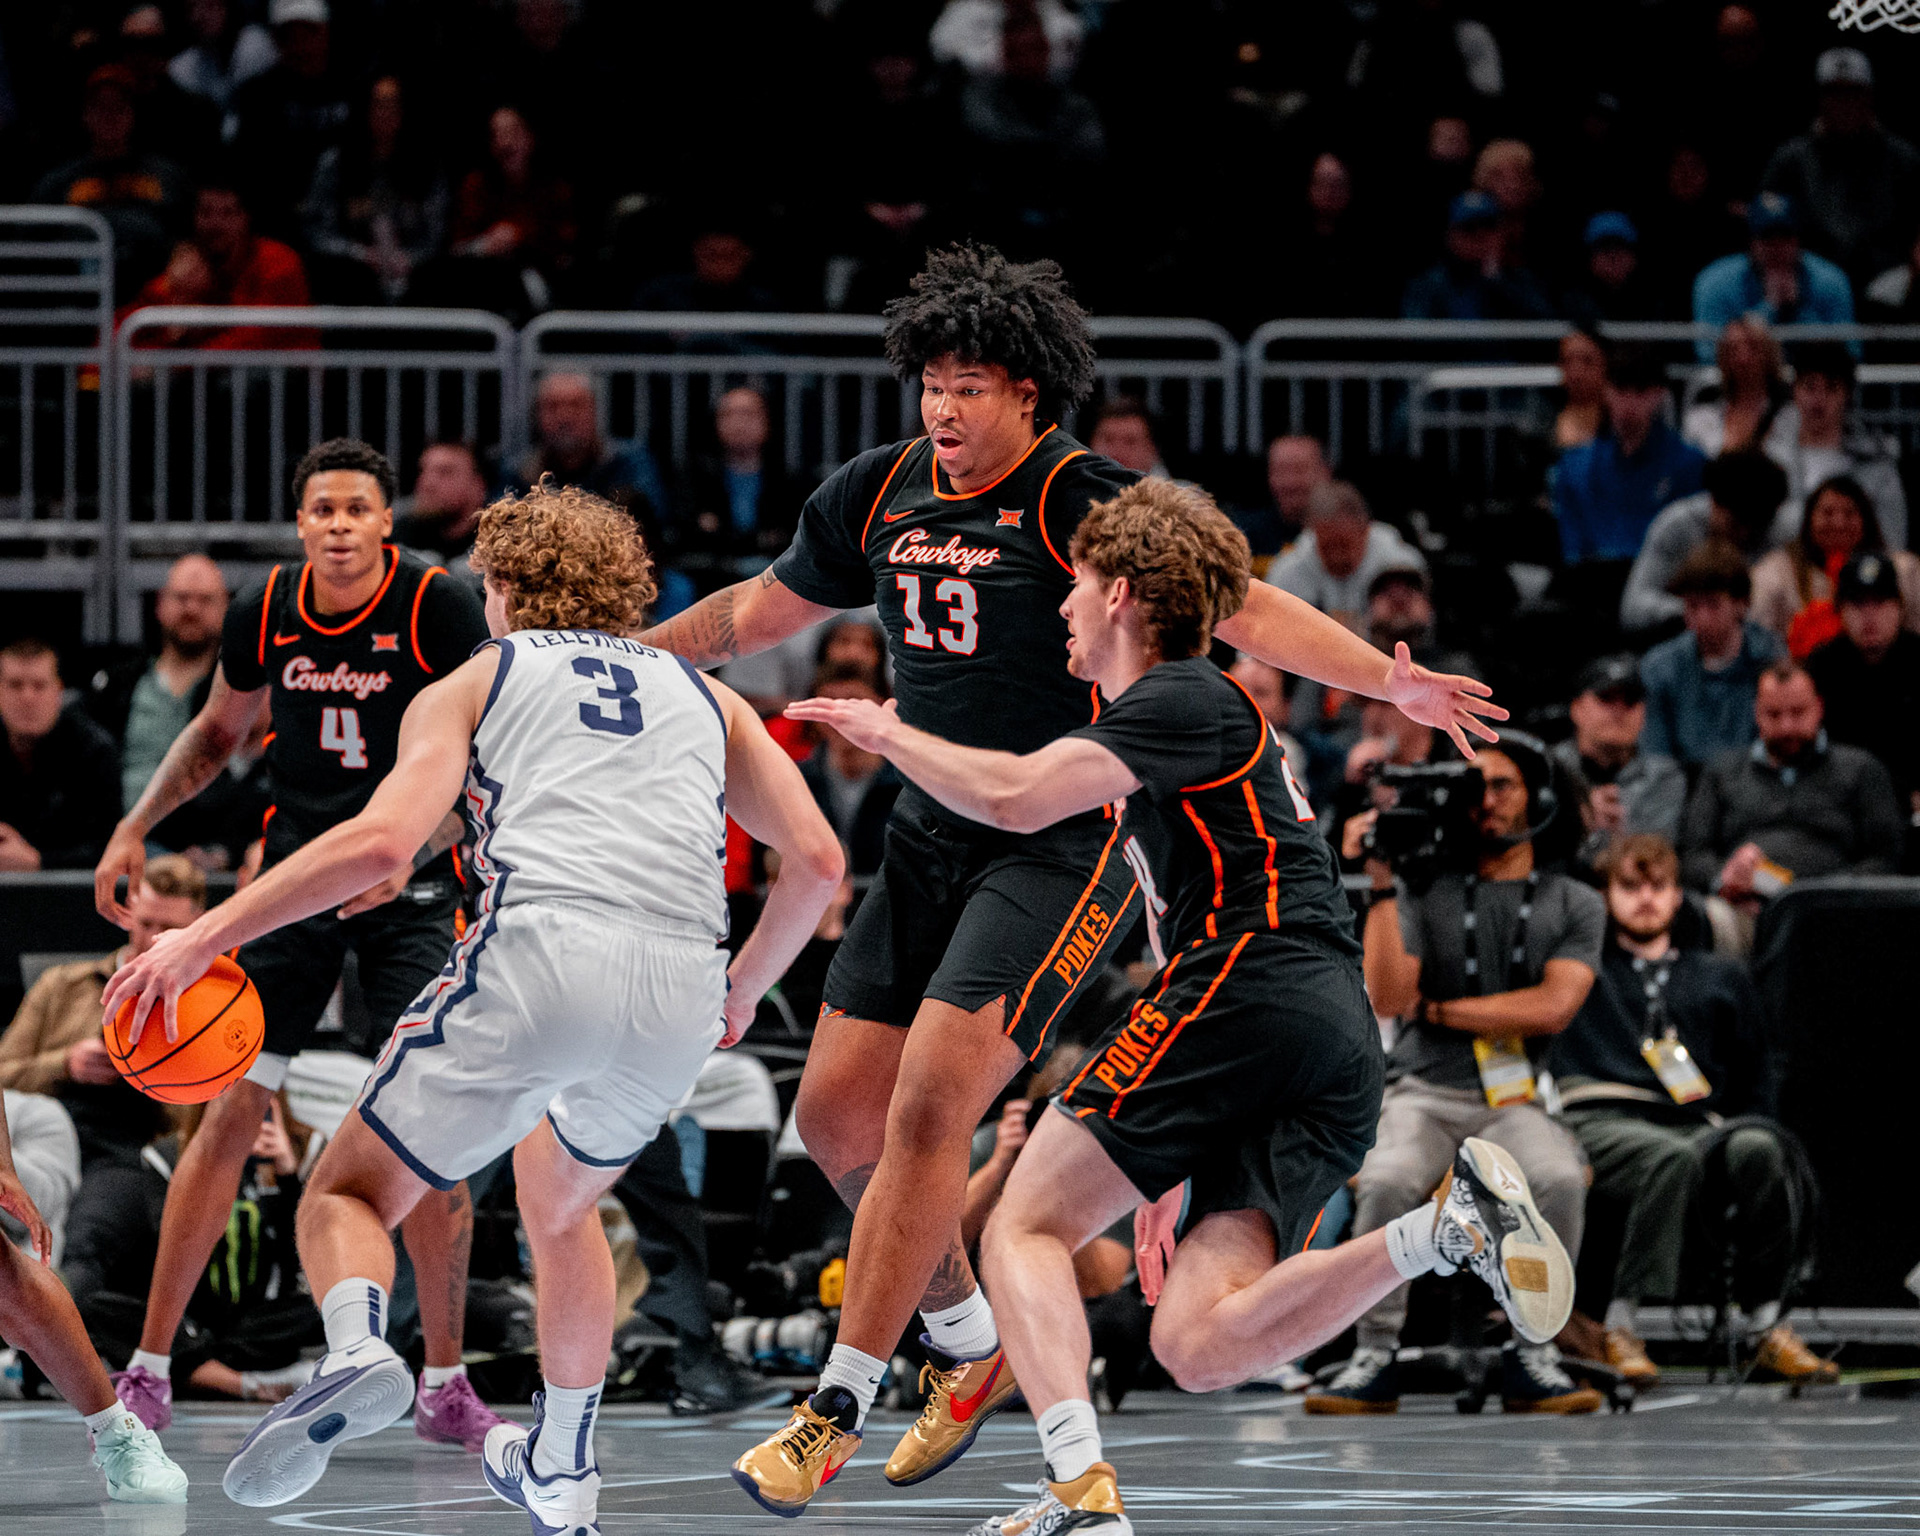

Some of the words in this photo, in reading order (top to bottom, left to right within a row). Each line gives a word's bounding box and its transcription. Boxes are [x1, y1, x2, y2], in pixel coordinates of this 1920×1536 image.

[888, 527, 1001, 576] Cowboys
[896, 572, 979, 656] 13
[282, 655, 393, 700] Cowboys
[571, 656, 644, 736] 3
[319, 706, 369, 769] 4
[1053, 903, 1110, 986] POKES
[1094, 1003, 1169, 1093] POKES
